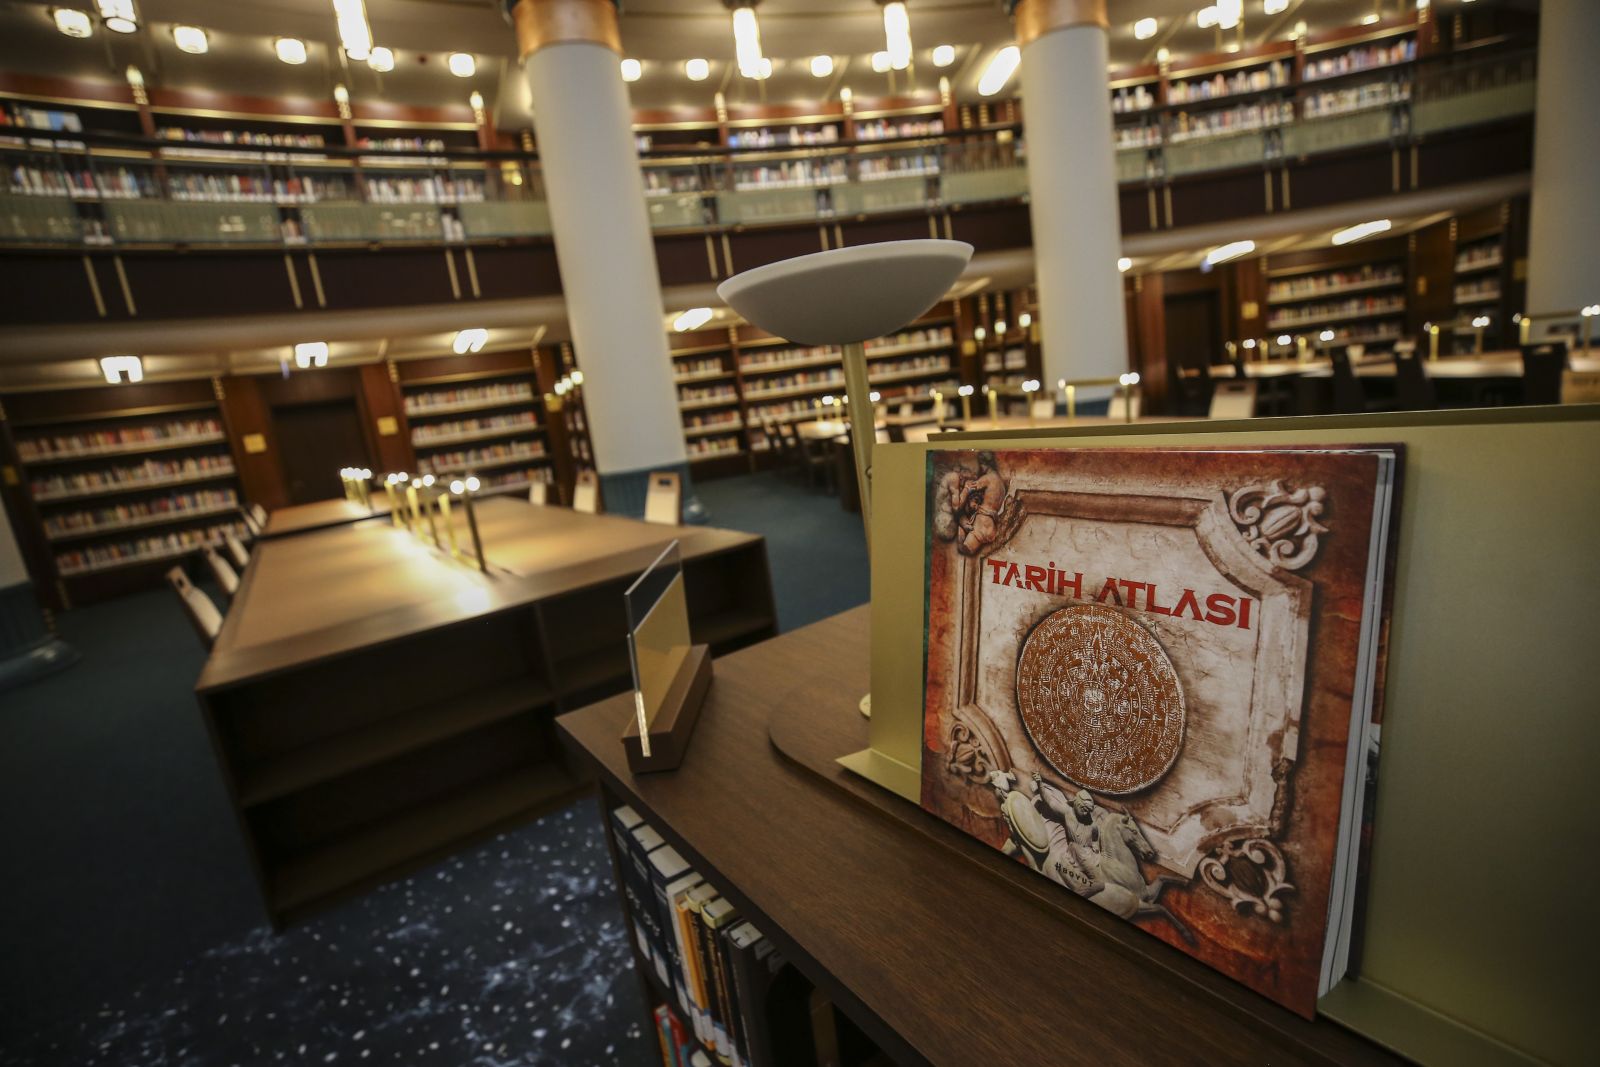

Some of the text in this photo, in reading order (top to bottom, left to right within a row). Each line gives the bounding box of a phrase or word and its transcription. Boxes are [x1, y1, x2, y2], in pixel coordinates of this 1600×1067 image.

[987, 558, 1252, 629] TARİH ATLASI
[1063, 867, 1093, 887] BOYUT
